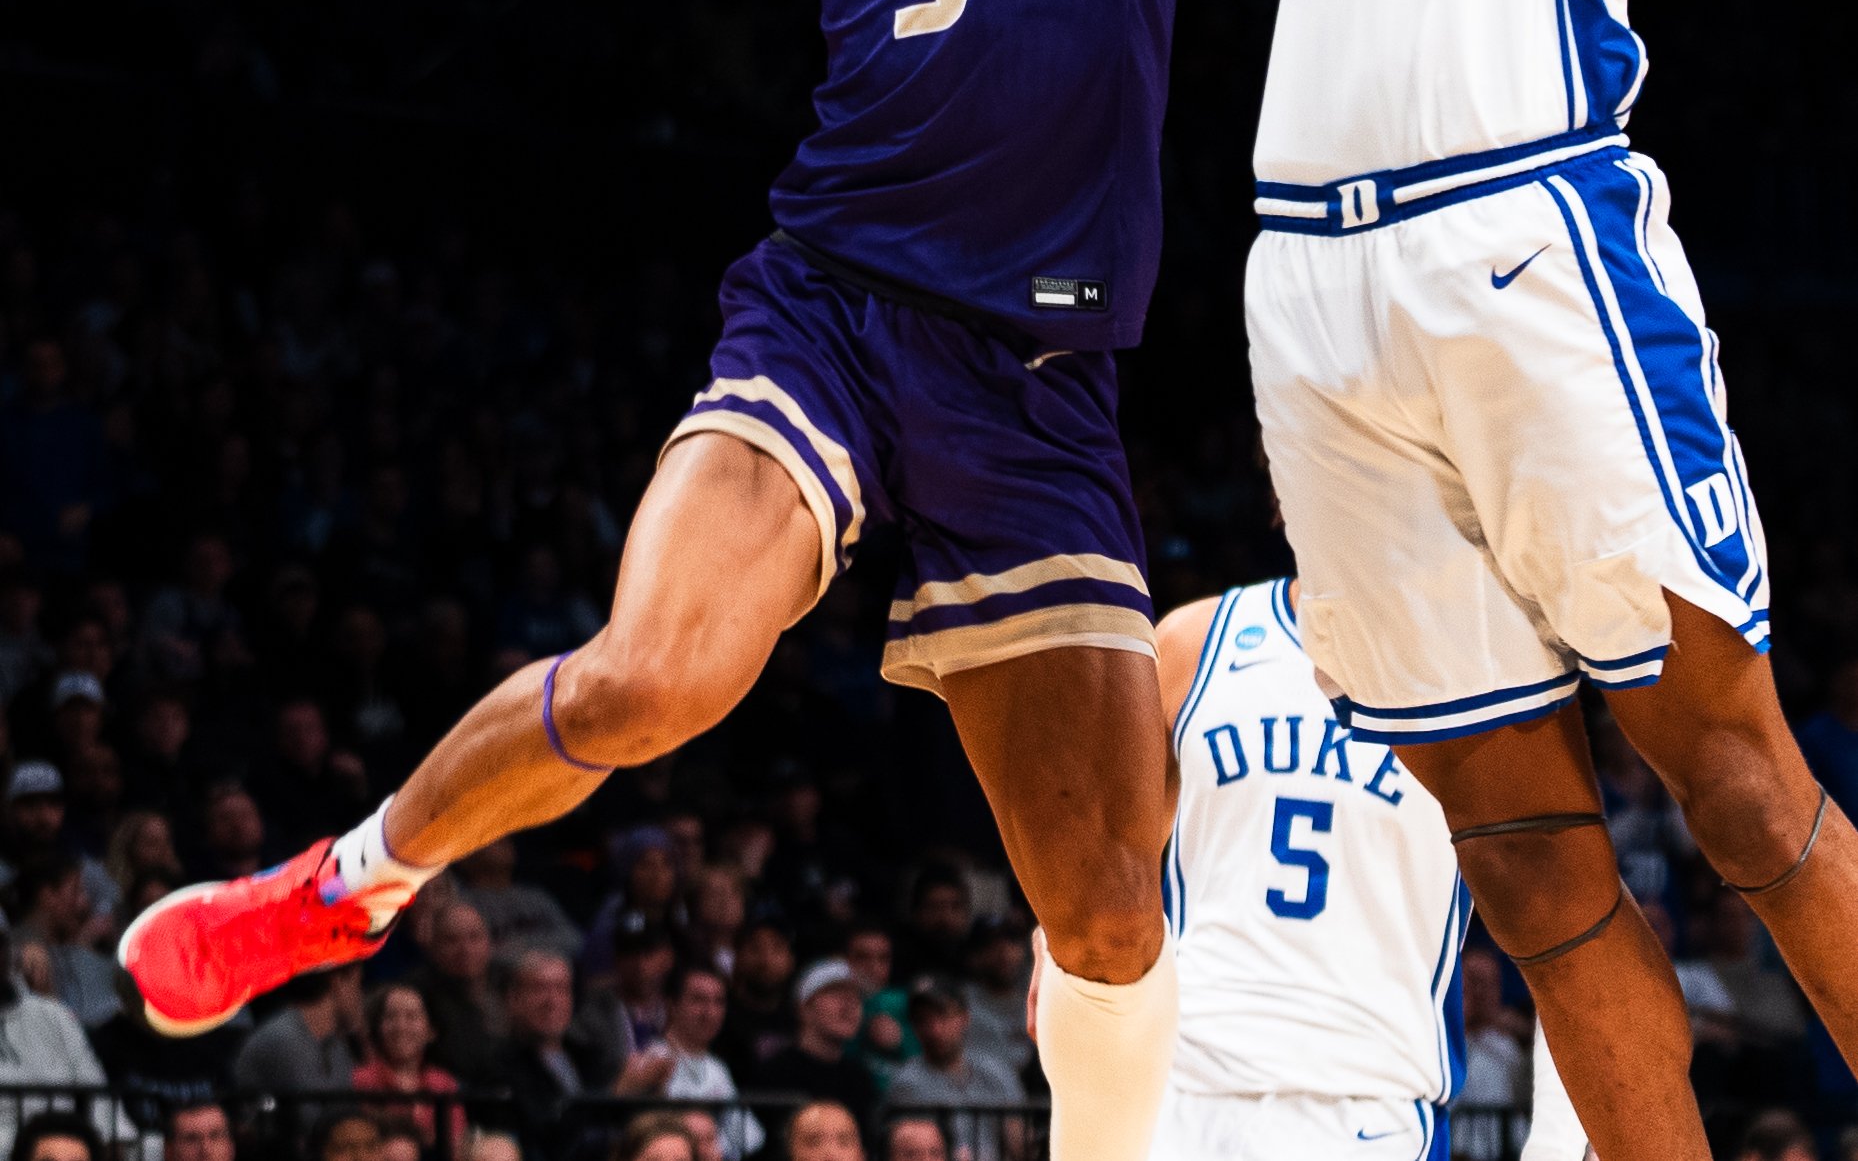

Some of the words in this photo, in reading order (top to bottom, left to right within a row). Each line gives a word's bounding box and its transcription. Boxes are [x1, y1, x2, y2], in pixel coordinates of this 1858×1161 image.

[1084, 287, 1098, 301] M
[1203, 715, 1404, 807] DUKE
[1266, 796, 1335, 921] 5
